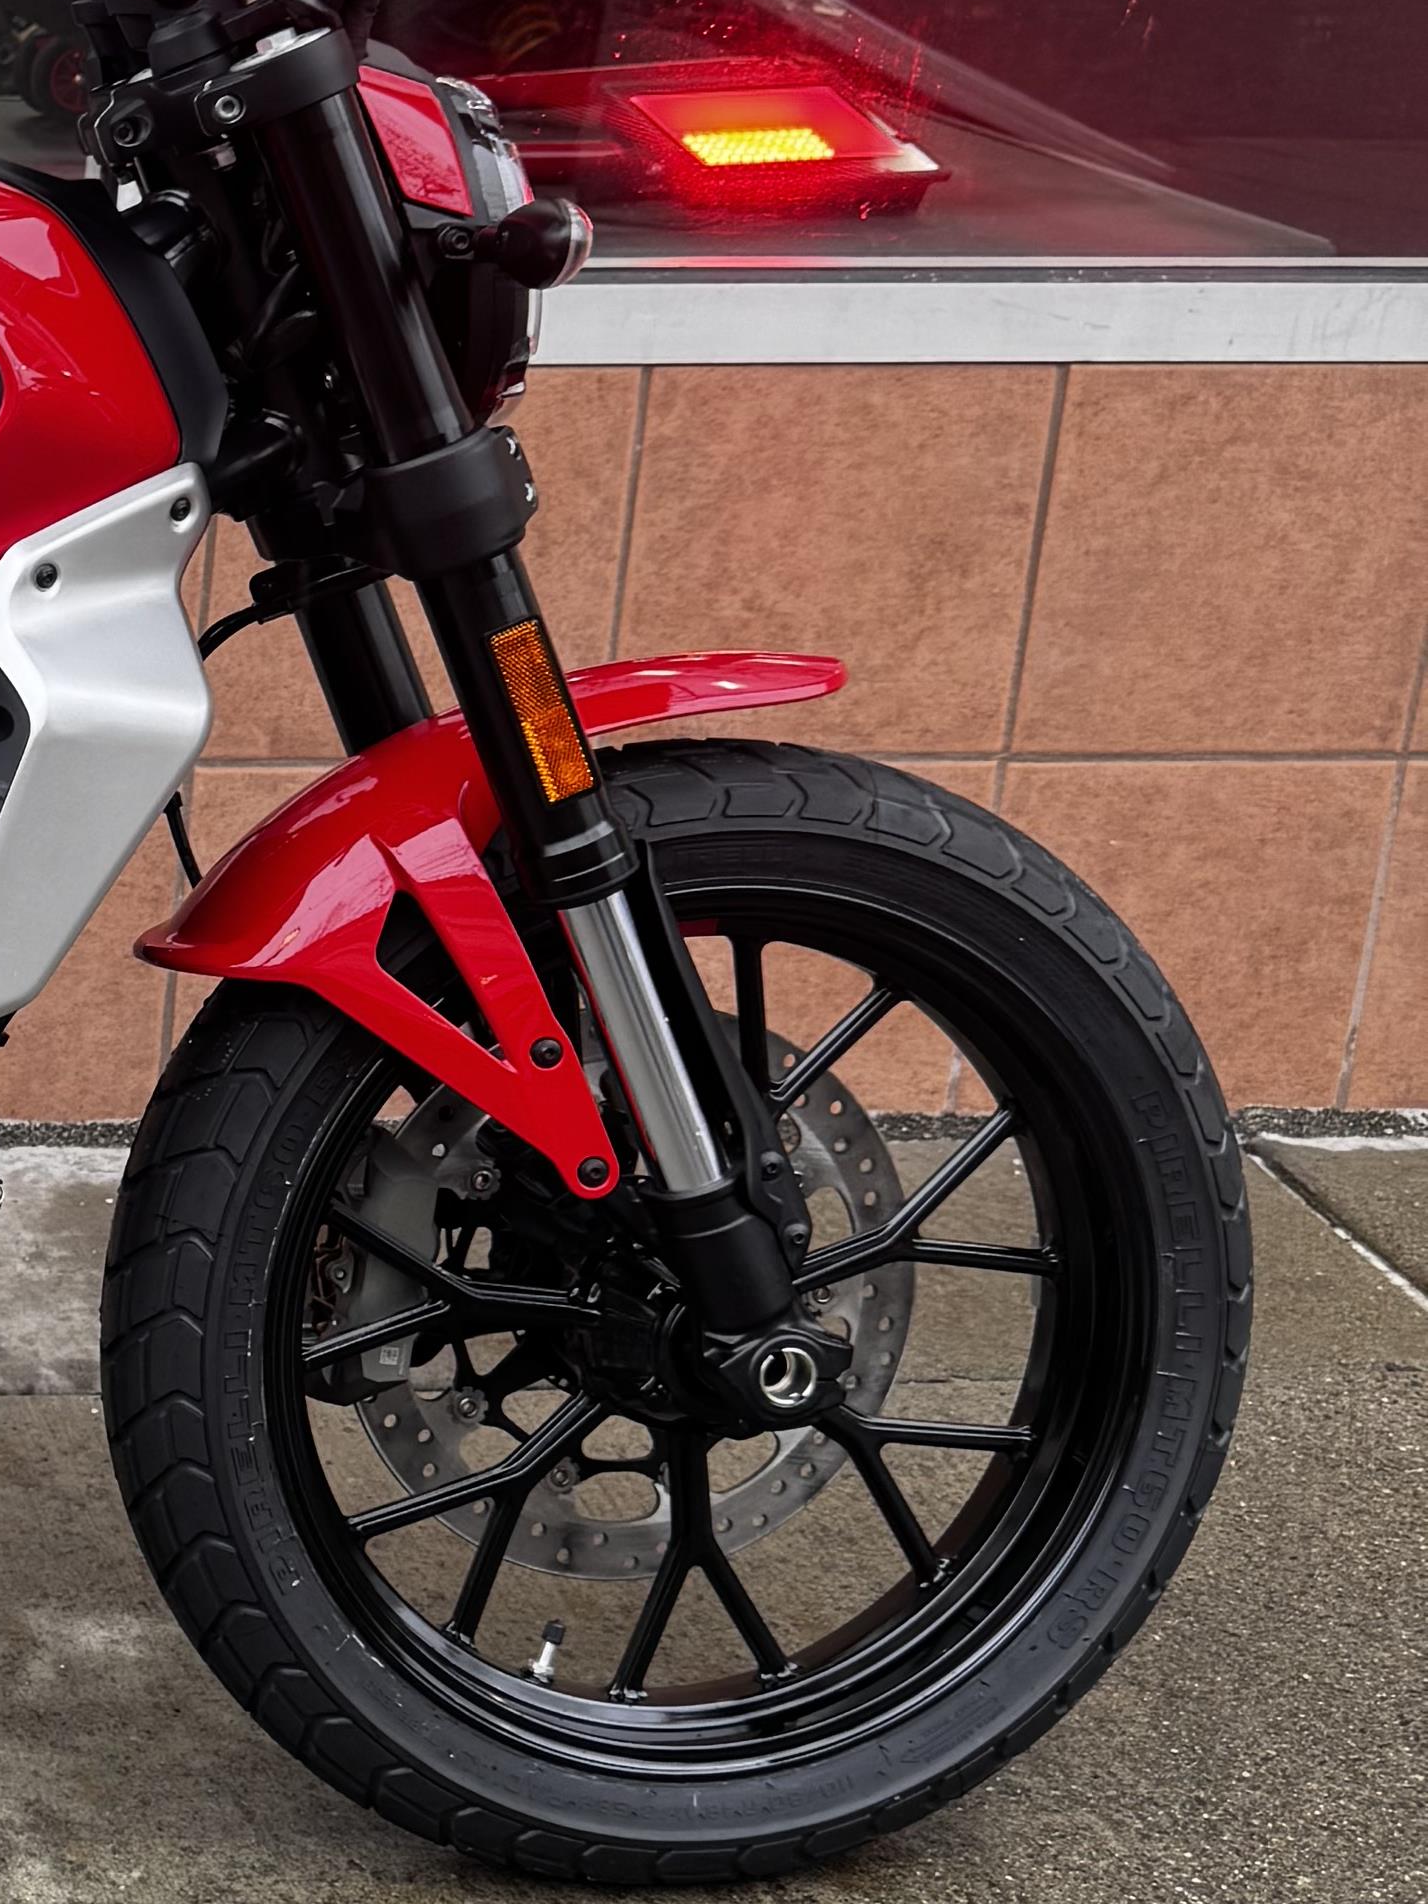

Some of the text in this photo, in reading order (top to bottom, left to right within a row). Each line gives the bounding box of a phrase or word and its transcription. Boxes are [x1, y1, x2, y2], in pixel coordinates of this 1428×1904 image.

[224, 1329, 302, 1593] PIRELLI
[1046, 1089, 1203, 1650] PIRELLI MT60 RS
